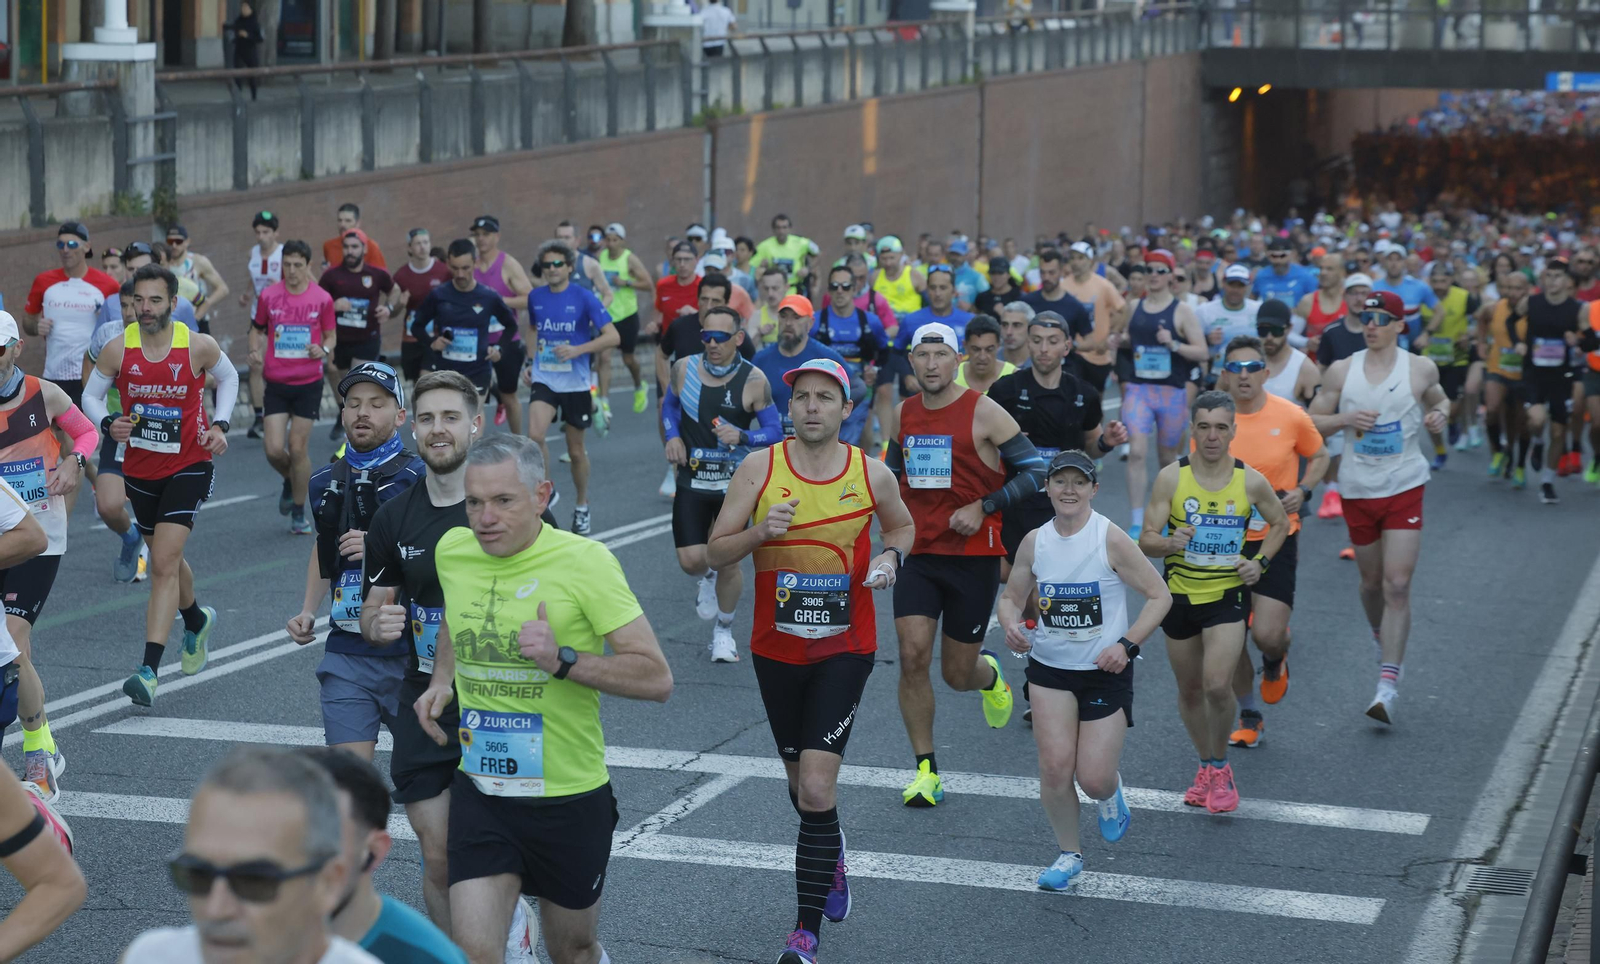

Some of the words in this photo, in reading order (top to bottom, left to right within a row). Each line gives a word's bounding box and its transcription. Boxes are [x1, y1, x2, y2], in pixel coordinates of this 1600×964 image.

[543, 318, 576, 332] Aural
[147, 407, 177, 417] ZURICH
[141, 428, 169, 442] NIETO
[917, 438, 945, 446] ZURICH
[3, 461, 37, 473] ZURICH
[918, 467, 929, 476] MY
[930, 467, 951, 476] BEER
[1205, 517, 1239, 526] ZURICH
[1204, 532, 1223, 541] 4757
[1188, 540, 1238, 554] FEDERICO
[801, 578, 841, 587] ZURICH
[1058, 586, 1093, 595] ZURICH
[802, 597, 824, 607] 3905
[1060, 603, 1079, 613] 3882
[794, 609, 830, 624] GREG
[1050, 614, 1093, 628] NICOLA
[471, 682, 544, 699] FINISHER
[484, 716, 531, 729] ZURICH
[485, 741, 509, 753] 5605
[480, 756, 518, 775] FRED
